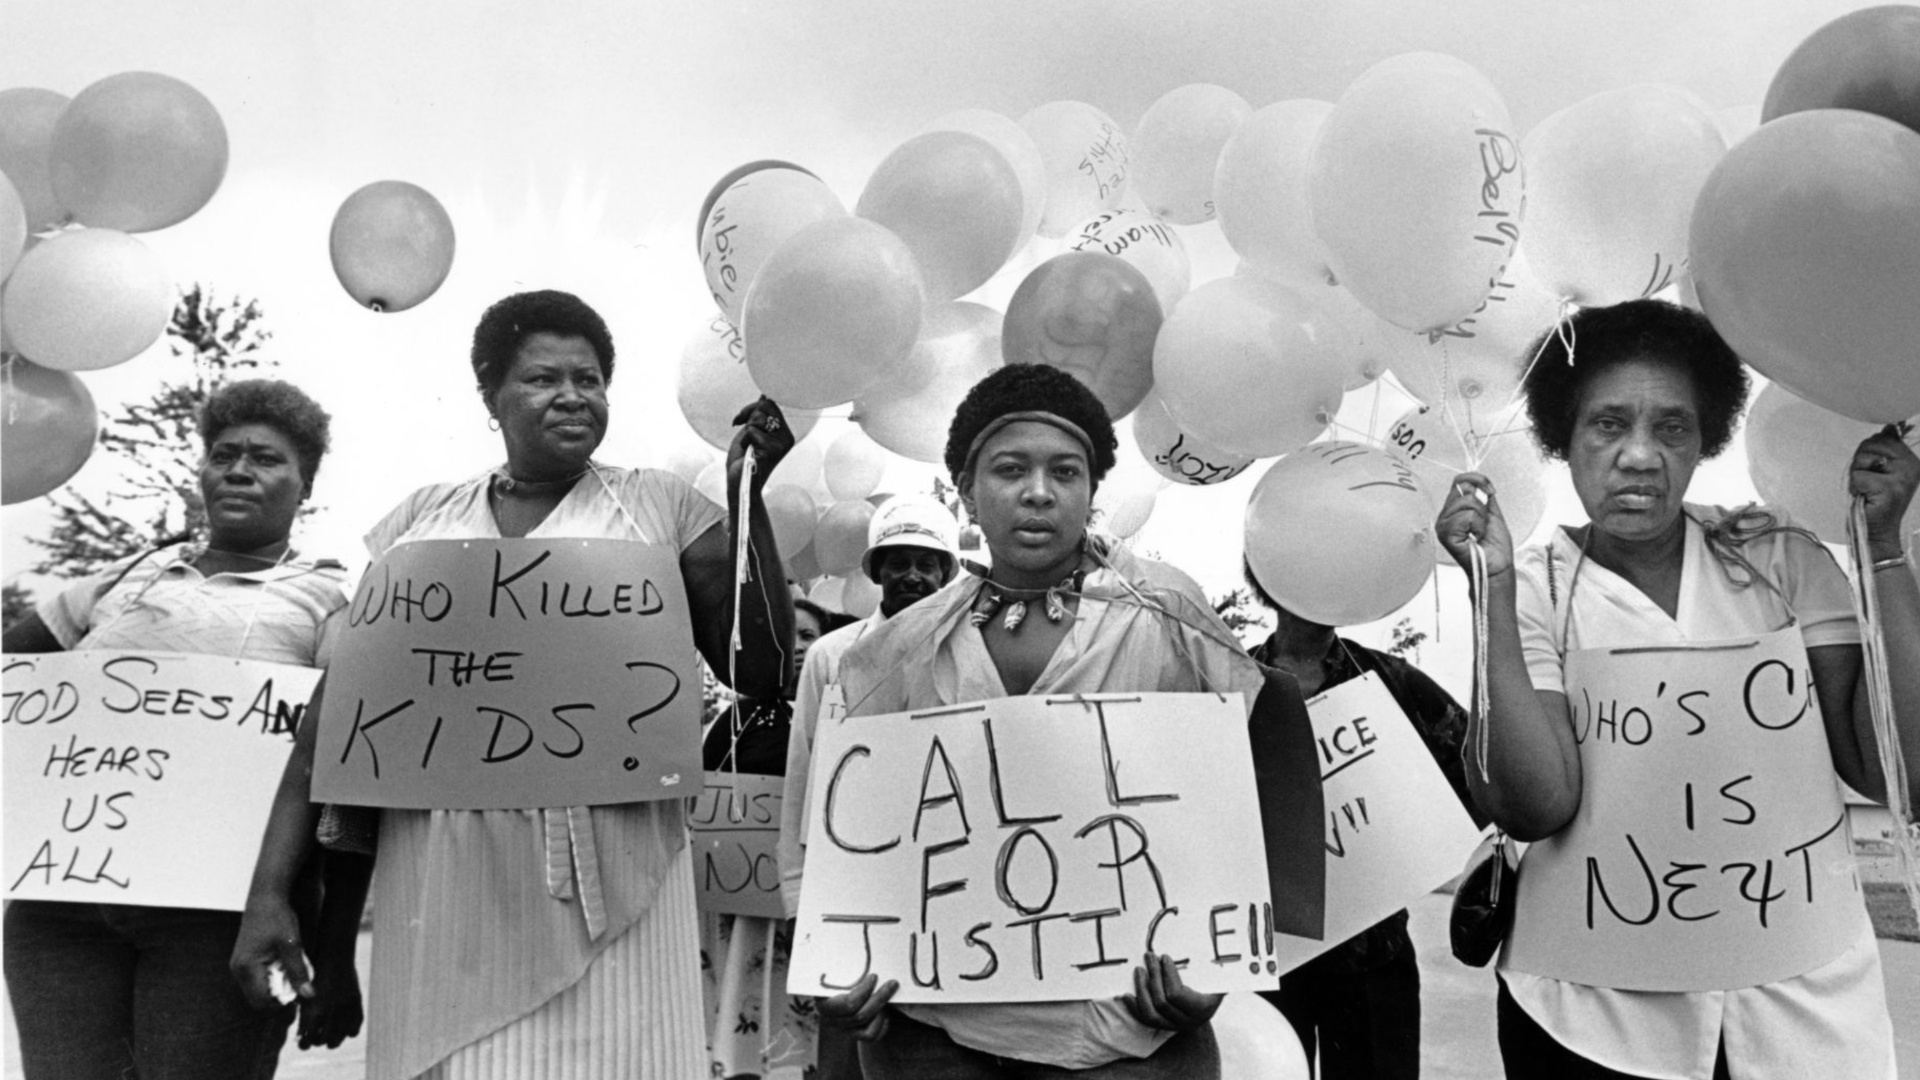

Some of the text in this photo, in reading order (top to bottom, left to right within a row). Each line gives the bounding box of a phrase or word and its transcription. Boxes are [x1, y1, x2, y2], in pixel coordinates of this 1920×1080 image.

[350, 549, 665, 628] WHO KILLED
[411, 648, 524, 687] THE
[101, 656, 234, 721] SEES
[237, 677, 309, 743] AN
[43, 734, 171, 781] HEARS
[825, 698, 1181, 854] CALL
[62, 791, 135, 833] US
[691, 784, 783, 825] JUS
[1685, 774, 1757, 831] IS
[10, 839, 130, 892] ALL
[918, 813, 1168, 934] FOR
